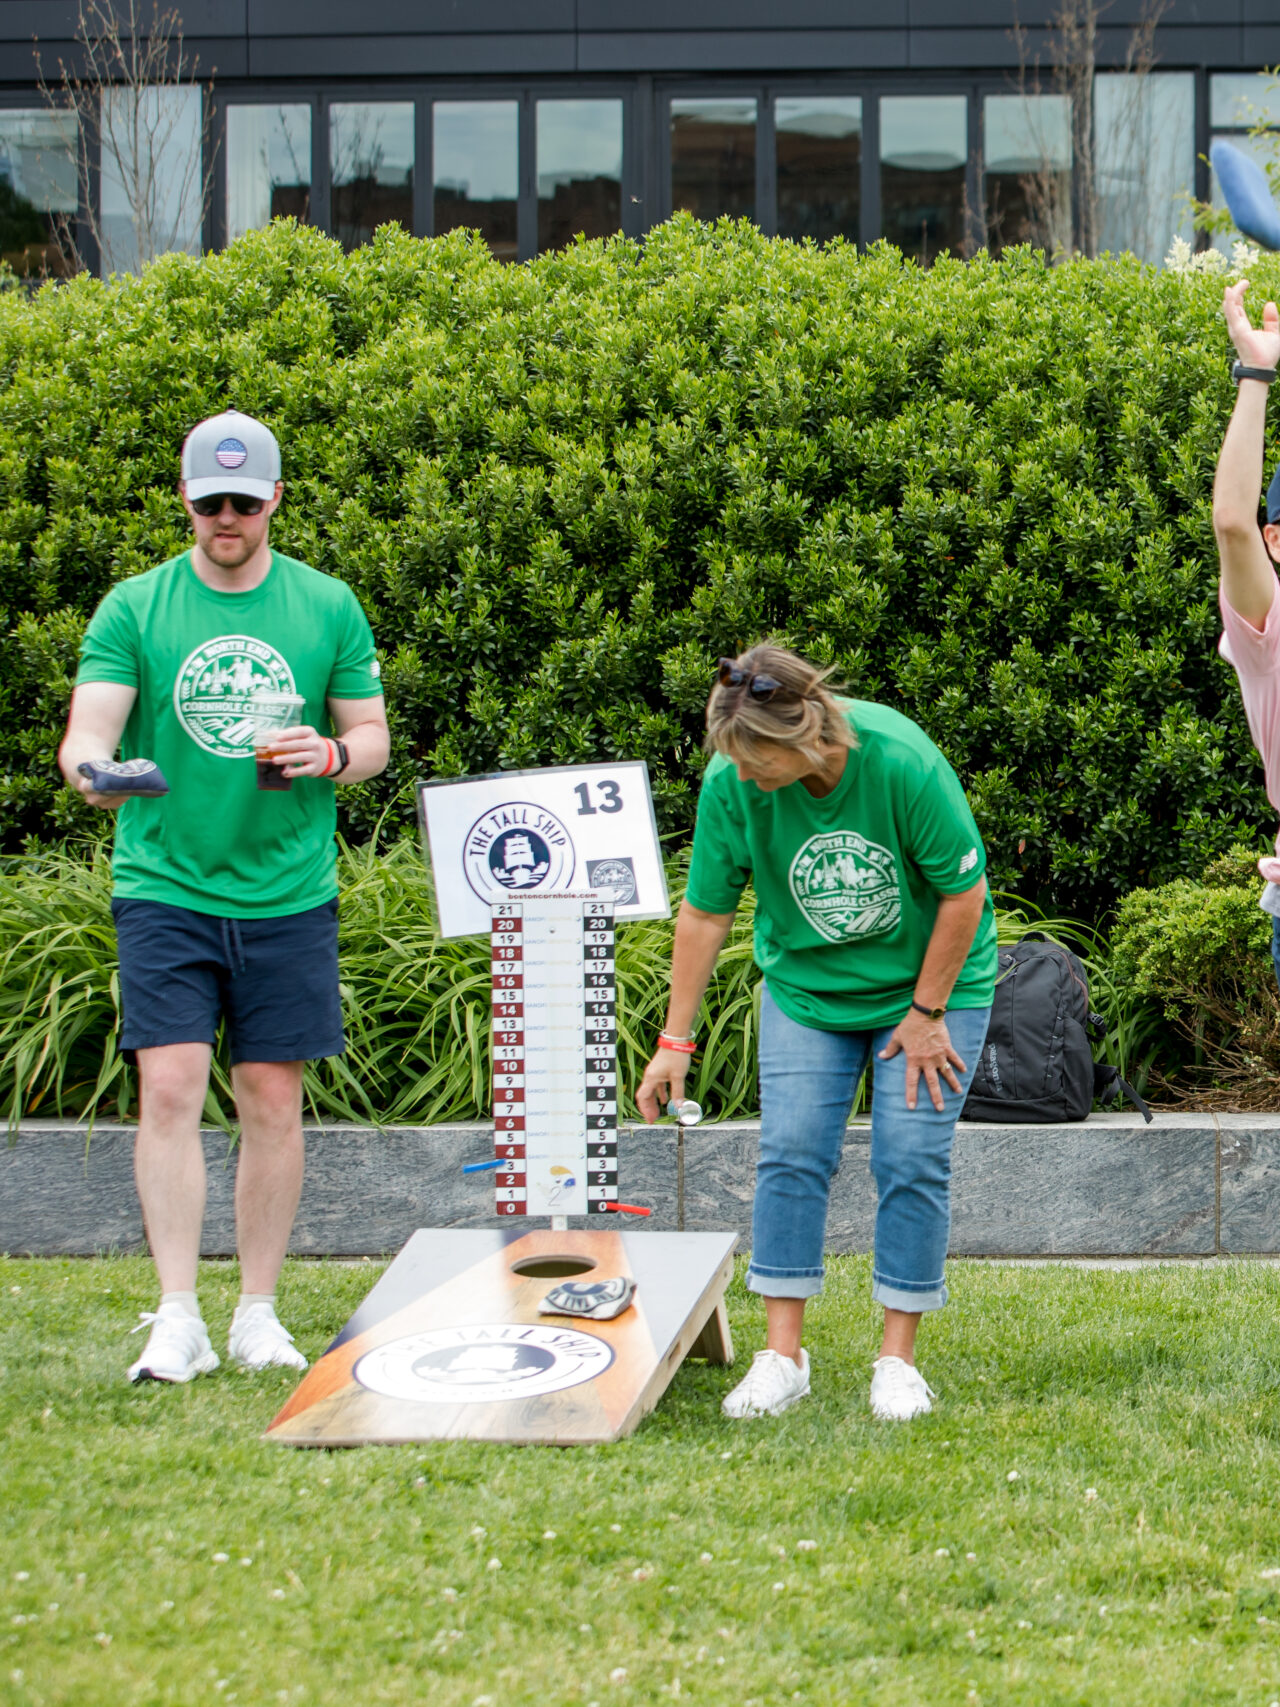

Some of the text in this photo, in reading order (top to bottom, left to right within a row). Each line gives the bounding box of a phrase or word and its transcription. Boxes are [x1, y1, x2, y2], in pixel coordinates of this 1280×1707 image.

[202, 640, 272, 660] NORTH END
[181, 702, 243, 713] CORNHOLE
[574, 779, 624, 815] 13
[469, 807, 566, 858] THE TALL SHIP
[845, 836, 867, 853] END
[507, 891, 598, 900] bostoncornhole.com
[801, 896, 858, 909] CORNHOLE
[498, 905, 512, 915] 21
[590, 904, 604, 914] 21
[497, 920, 514, 930] 20
[589, 918, 606, 929] 20
[500, 934, 514, 944] 19
[592, 933, 606, 942] 19
[498, 948, 514, 958] 18
[590, 947, 606, 957] 18
[500, 962, 515, 972] 17
[592, 961, 607, 971] 17
[499, 976, 515, 986] 16
[590, 975, 607, 985] 16
[501, 991, 515, 1000] 15
[593, 989, 608, 999] 15
[500, 1005, 516, 1015] 14
[592, 1003, 608, 1013] 14
[501, 1019, 516, 1029] 13
[594, 1018, 608, 1027] 13
[501, 1033, 517, 1043] 12
[593, 1031, 609, 1041] 12
[502, 1048, 515, 1057] 11
[594, 1046, 607, 1055] 11
[501, 1061, 517, 1071] 10
[593, 1060, 609, 1070] 10
[505, 1076, 513, 1085] 9
[598, 1074, 605, 1084] 9
[505, 1089, 514, 1100] 8
[597, 1088, 606, 1098] 8
[506, 1104, 514, 1114] 7
[598, 1103, 605, 1112] 7
[505, 1118, 514, 1128] 6
[597, 1116, 606, 1127] 6
[507, 1132, 514, 1142] 5
[599, 1131, 606, 1141] 5
[506, 1146, 515, 1156] 4
[597, 1145, 607, 1155] 4
[507, 1160, 514, 1170] 3
[599, 1159, 606, 1169] 3
[506, 1174, 514, 1185] 2
[597, 1173, 606, 1183] 2
[508, 1189, 513, 1198] 1
[548, 1185, 561, 1207] 2
[600, 1188, 605, 1197] 1
[506, 1203, 515, 1213] 0
[598, 1201, 607, 1211] 0
[457, 1328, 535, 1342] TALL
[541, 1334, 601, 1358] SHIP
